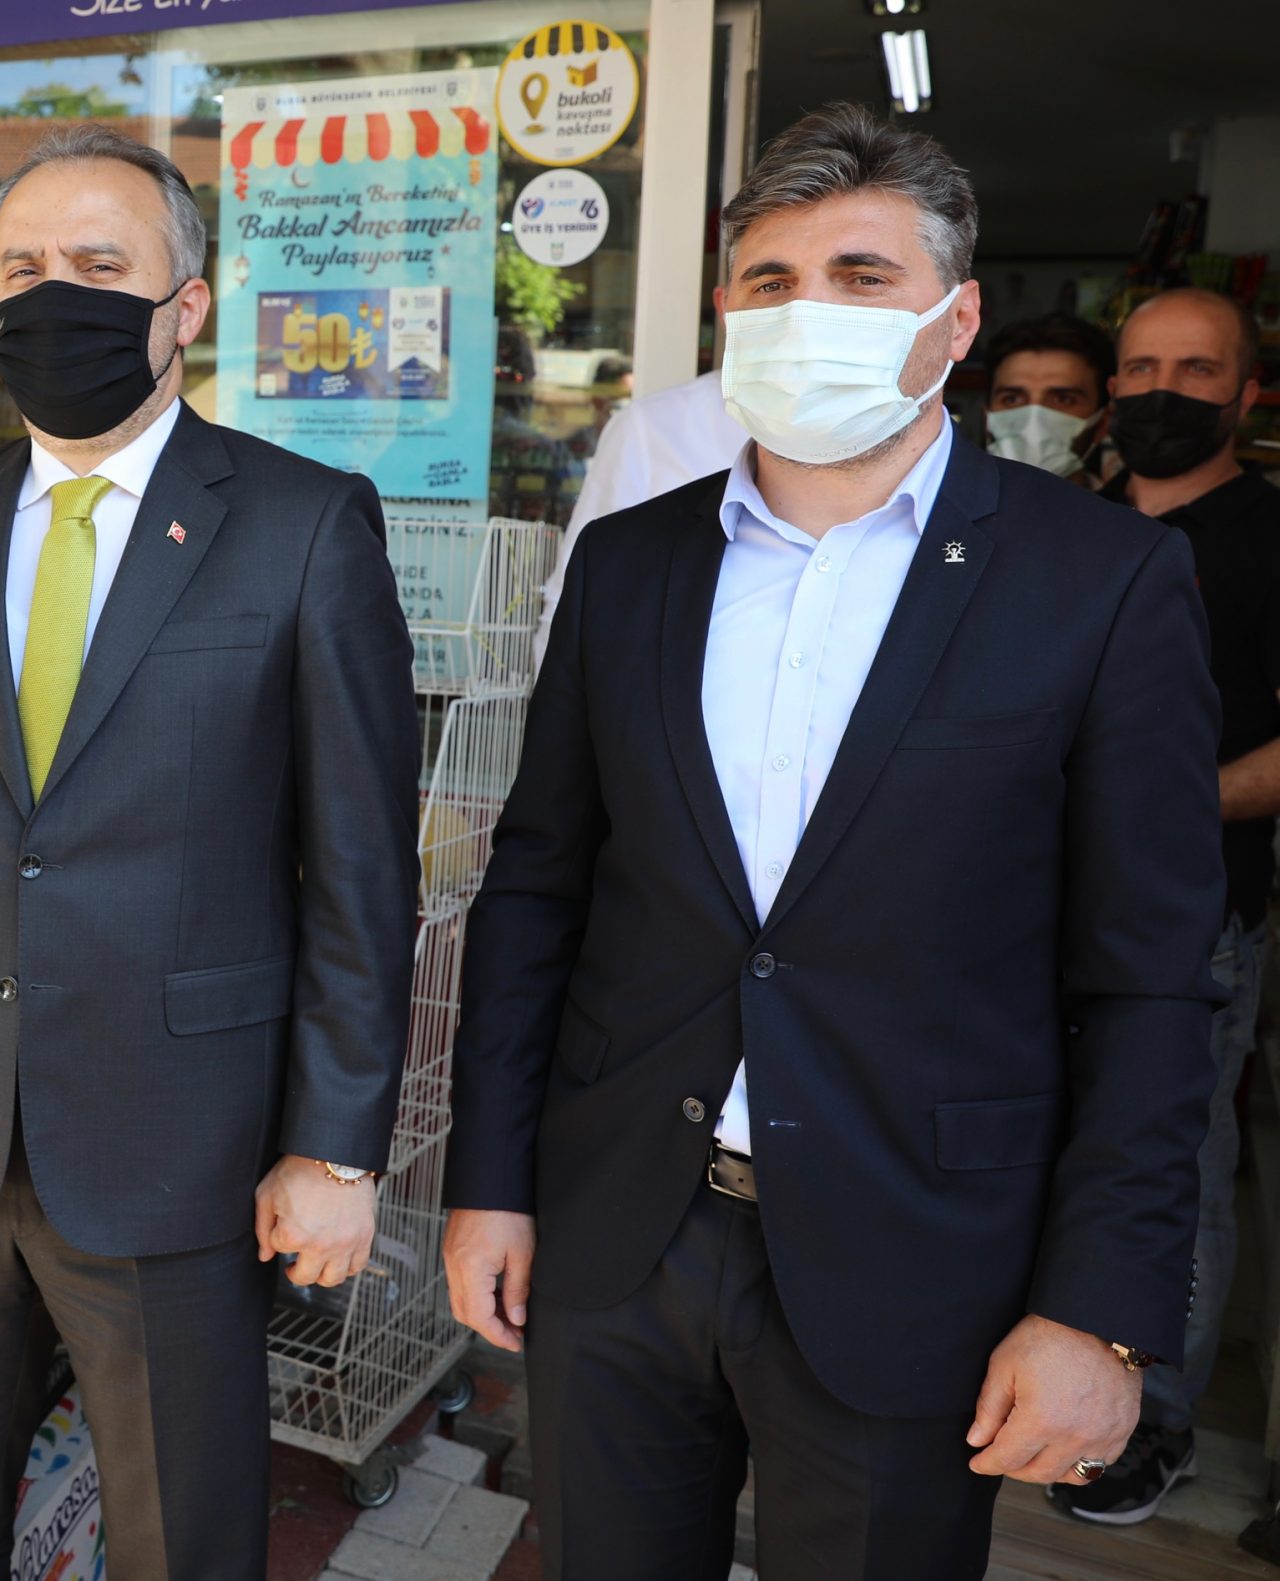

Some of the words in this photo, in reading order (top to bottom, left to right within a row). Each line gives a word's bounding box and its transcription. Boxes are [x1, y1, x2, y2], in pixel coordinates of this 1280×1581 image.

[558, 86, 613, 107] bukoli
[558, 108, 612, 122] kavuşma
[557, 122, 611, 137] noktası
[237, 214, 328, 241] Bakkal
[331, 209, 482, 237] Amcamızla
[282, 242, 435, 276] Paylaşıyoruz
